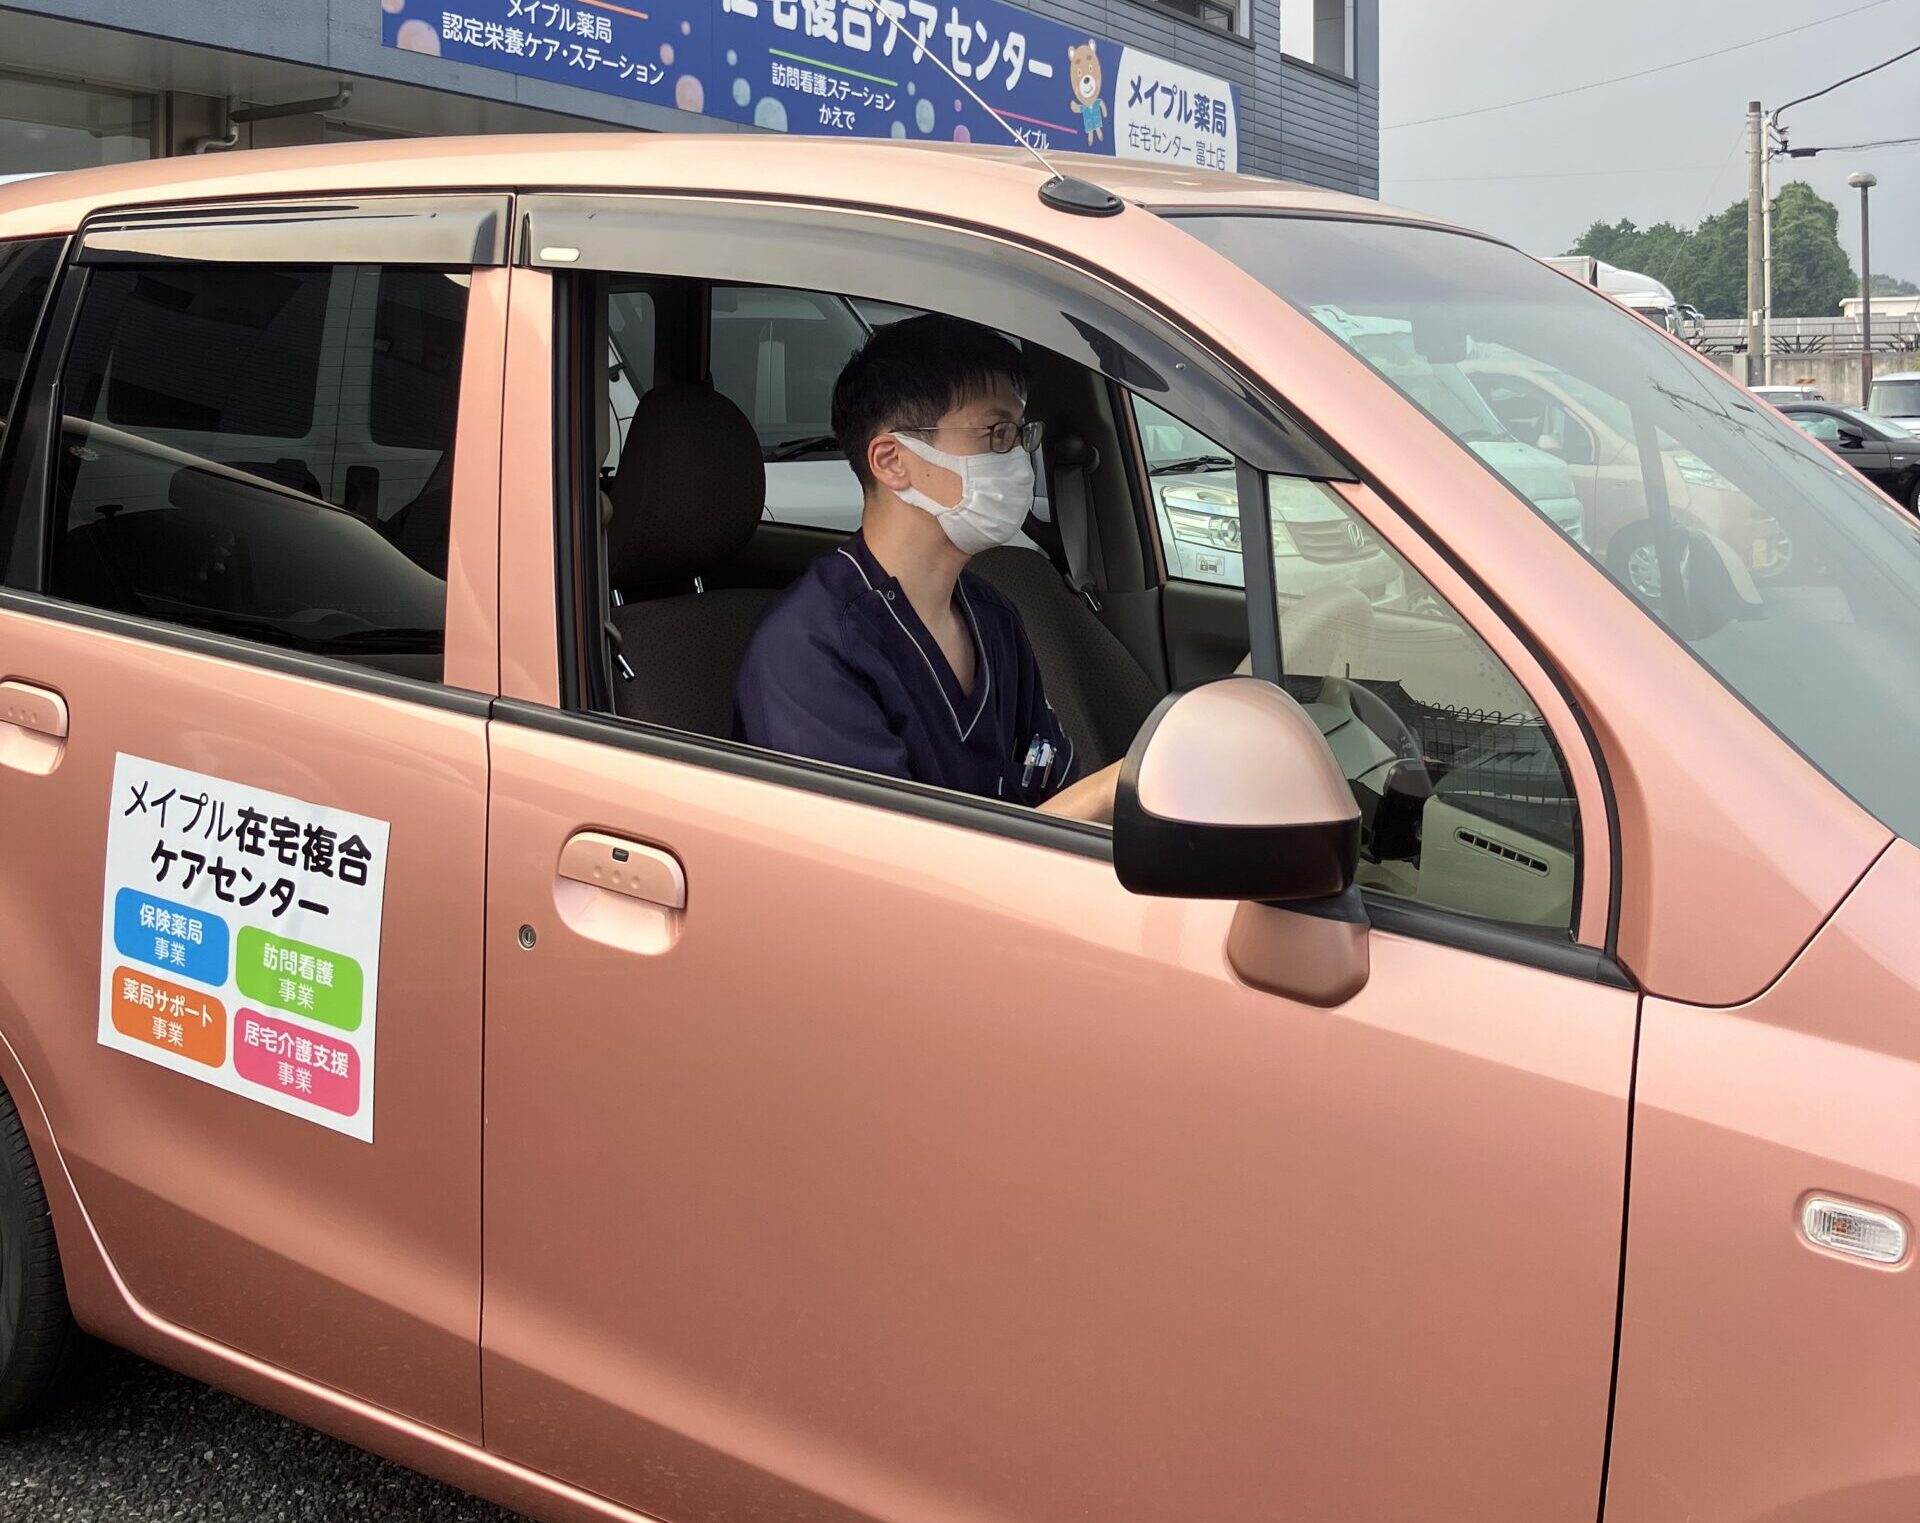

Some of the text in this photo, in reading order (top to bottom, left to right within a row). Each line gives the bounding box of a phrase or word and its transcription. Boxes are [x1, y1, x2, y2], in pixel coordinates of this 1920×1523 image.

[507, 0, 612, 44] メイプル薬局
[442, 11, 665, 86] 認定栄養ケア・ステーション
[771, 62, 896, 111] 訪問看護ステーション
[1128, 75, 1226, 138] メイプル薬局
[818, 105, 856, 131] かえで
[1128, 121, 1226, 171] 在宅センター 富士店
[124, 780, 372, 887] メイプル在宅複合
[151, 839, 330, 918] ケアセンター
[139, 903, 203, 945] 保険薬局
[154, 937, 186, 968] 事業
[263, 942, 334, 988] 訪問看護
[122, 977, 214, 1028] 薬局サポート
[279, 978, 315, 1011] 事業
[151, 1016, 184, 1048] 事業
[243, 1019, 349, 1079] 居宅介護支援
[277, 1061, 313, 1095] 事業
